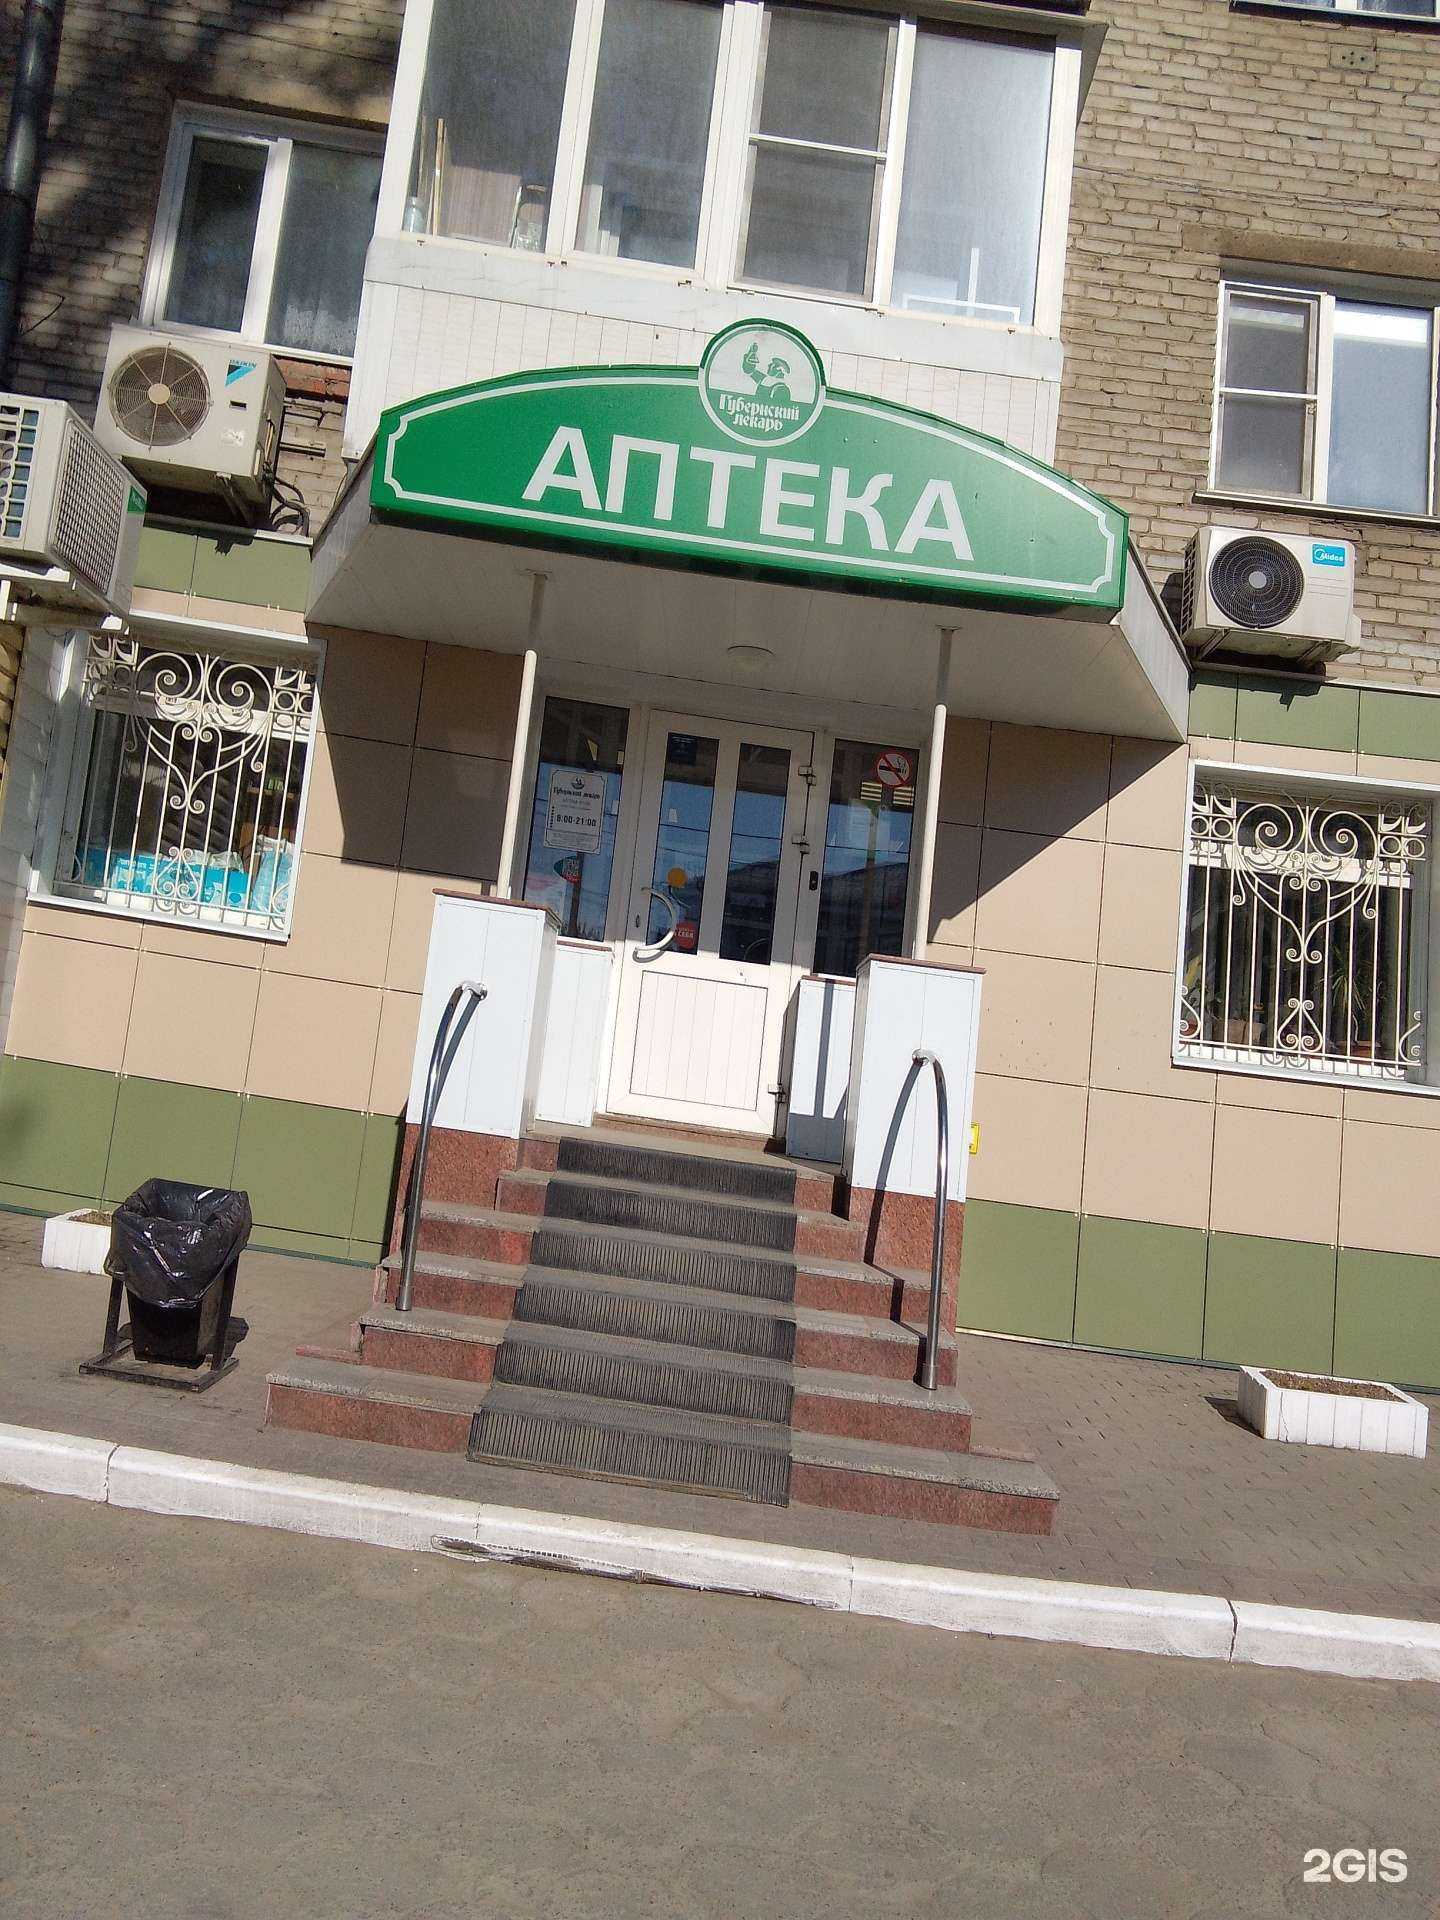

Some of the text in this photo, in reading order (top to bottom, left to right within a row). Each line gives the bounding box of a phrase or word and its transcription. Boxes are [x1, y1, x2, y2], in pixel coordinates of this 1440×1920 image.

[719, 393, 800, 421] Губернский
[732, 413, 784, 432] лекарь
[521, 425, 975, 562] АПТЕКА
[1316, 549, 1344, 562] Midea
